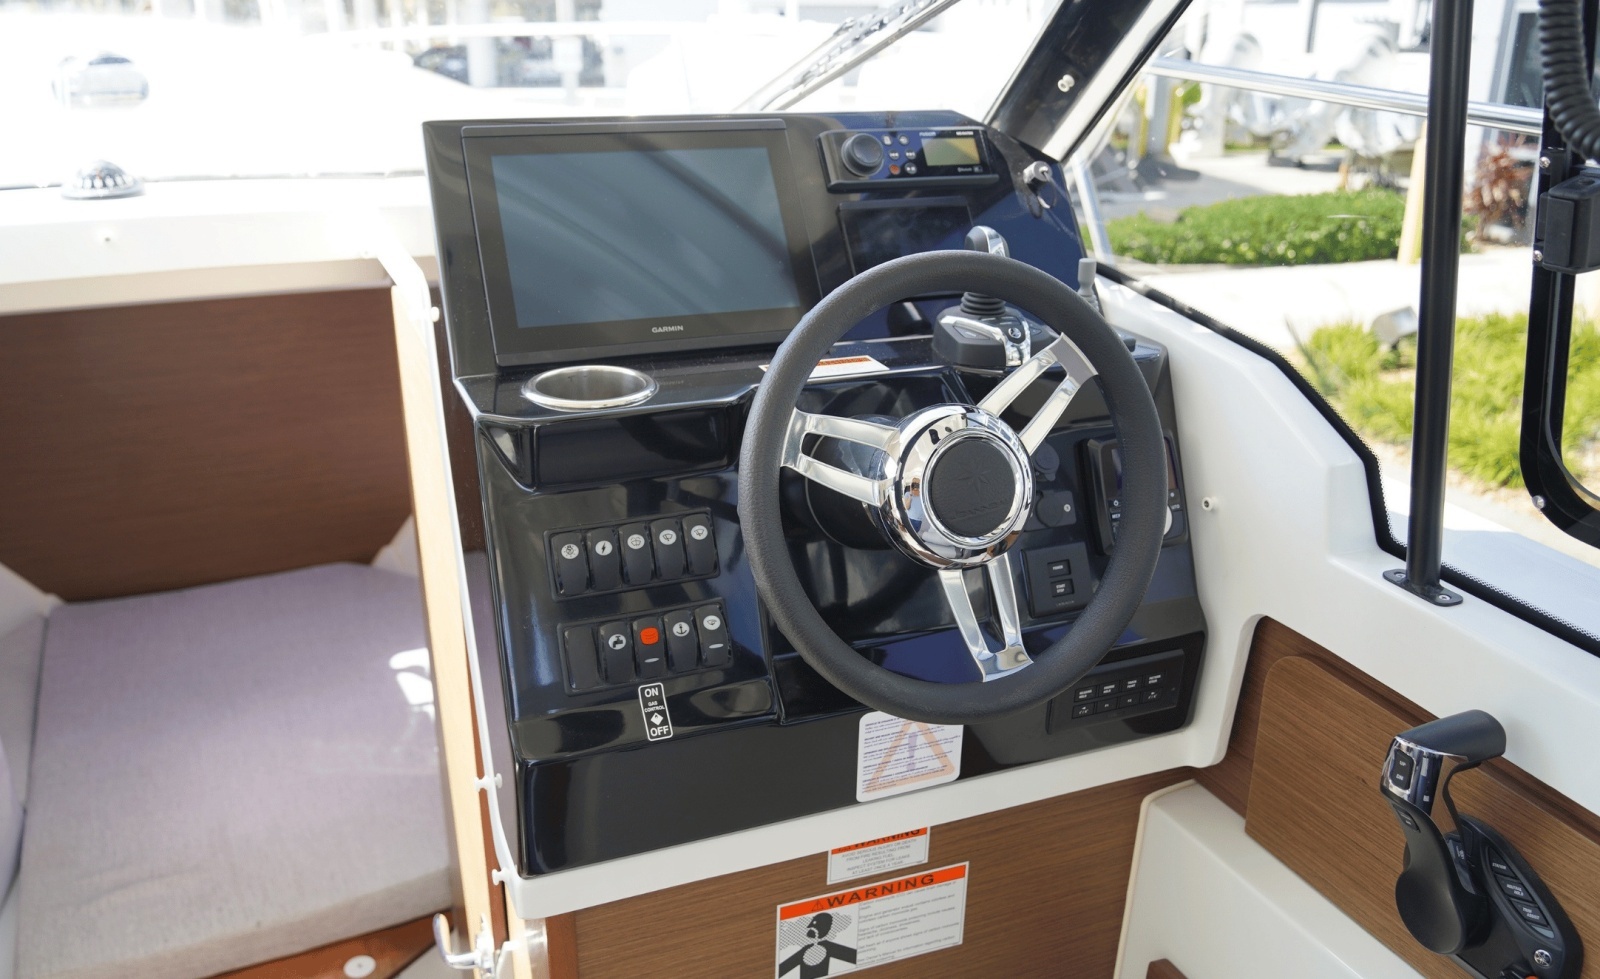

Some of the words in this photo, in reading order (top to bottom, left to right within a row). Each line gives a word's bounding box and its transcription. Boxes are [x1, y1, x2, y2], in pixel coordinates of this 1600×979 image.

[651, 325, 684, 334] GARMIN
[644, 687, 659, 698] ON
[650, 725, 669, 737] OFF
[827, 874, 935, 908] WARNING
